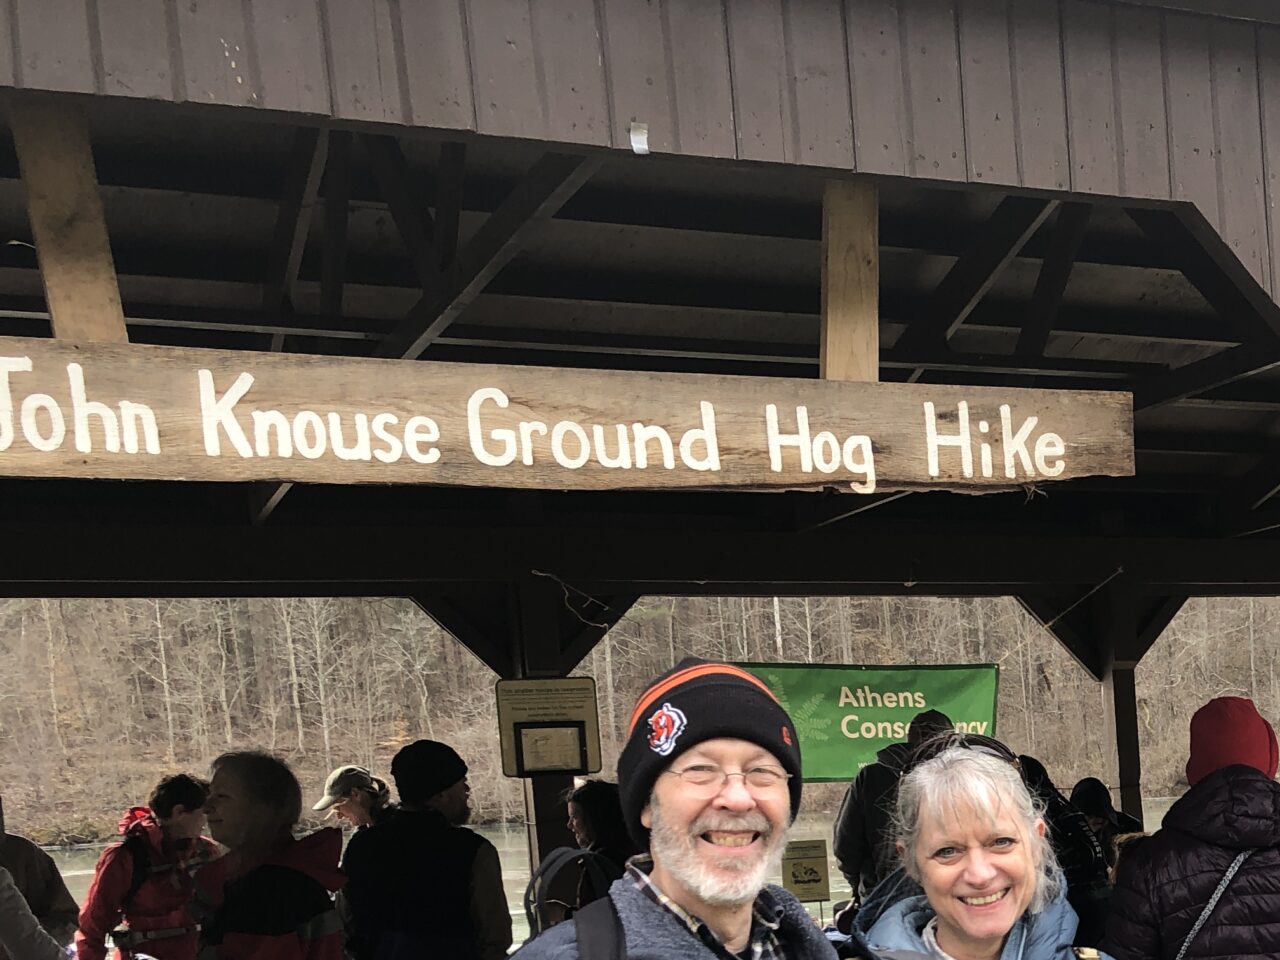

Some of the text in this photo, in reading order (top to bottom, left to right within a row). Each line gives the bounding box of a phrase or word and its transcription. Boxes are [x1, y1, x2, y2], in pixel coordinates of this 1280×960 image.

[0, 355, 161, 456] John
[197, 368, 441, 464] Knouse
[467, 387, 721, 472] Ground
[766, 400, 877, 494] Hog
[838, 685, 926, 709] Athens
[840, 714, 988, 739] Consncy
